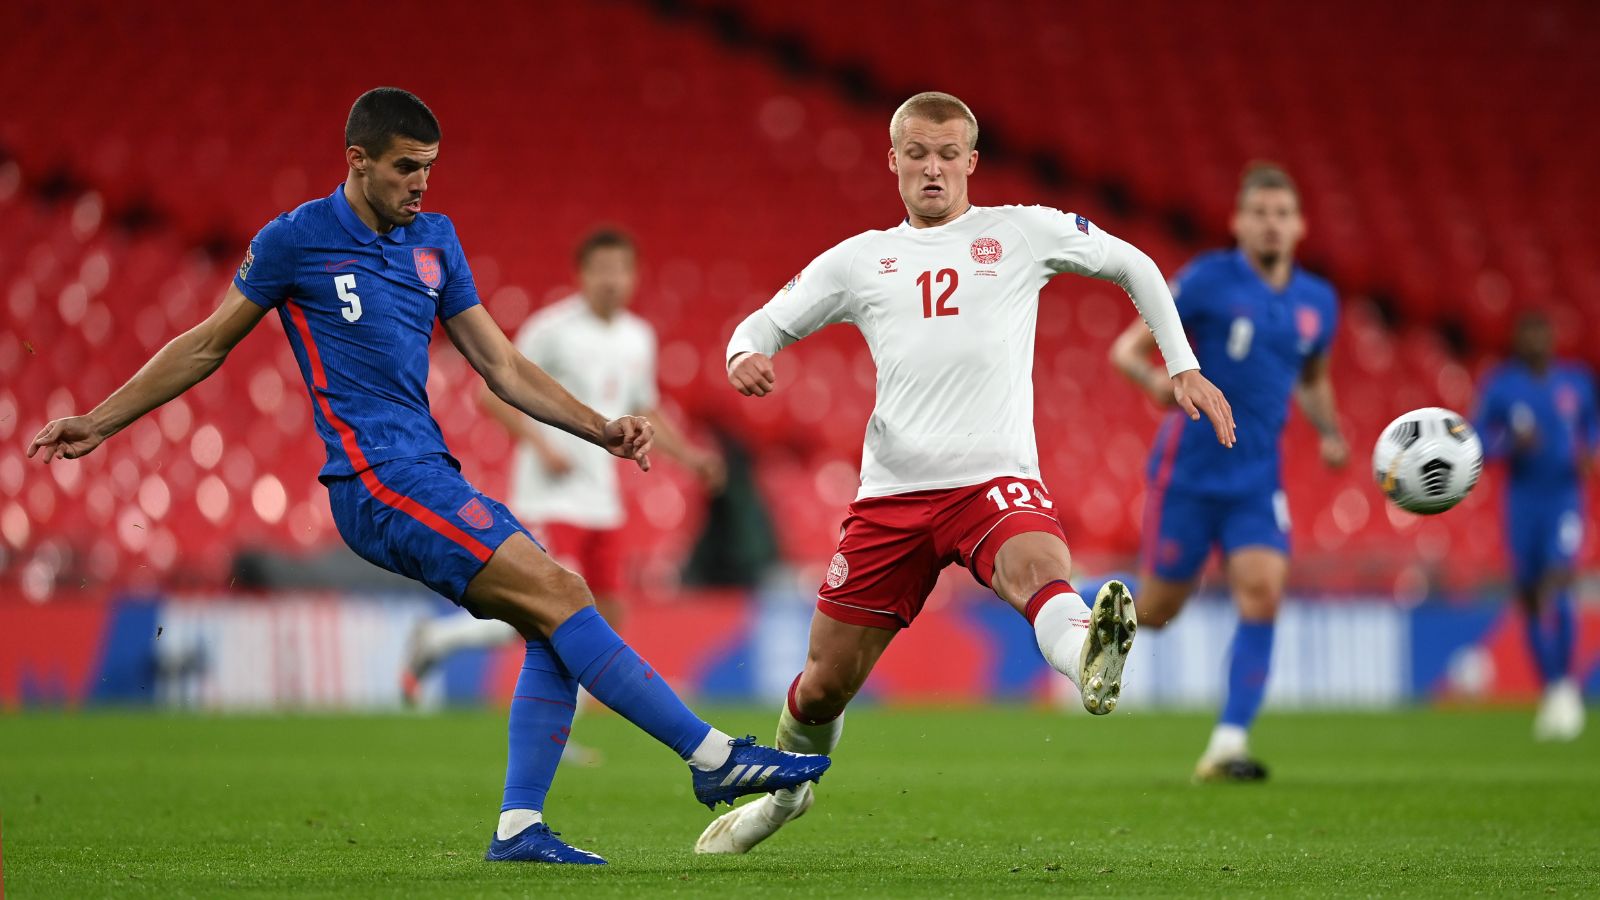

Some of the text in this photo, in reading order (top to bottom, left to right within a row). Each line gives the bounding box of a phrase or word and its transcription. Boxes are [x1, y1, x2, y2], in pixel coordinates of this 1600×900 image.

[977, 246, 996, 256] DBU
[334, 274, 363, 323] 5
[916, 268, 960, 319] 12
